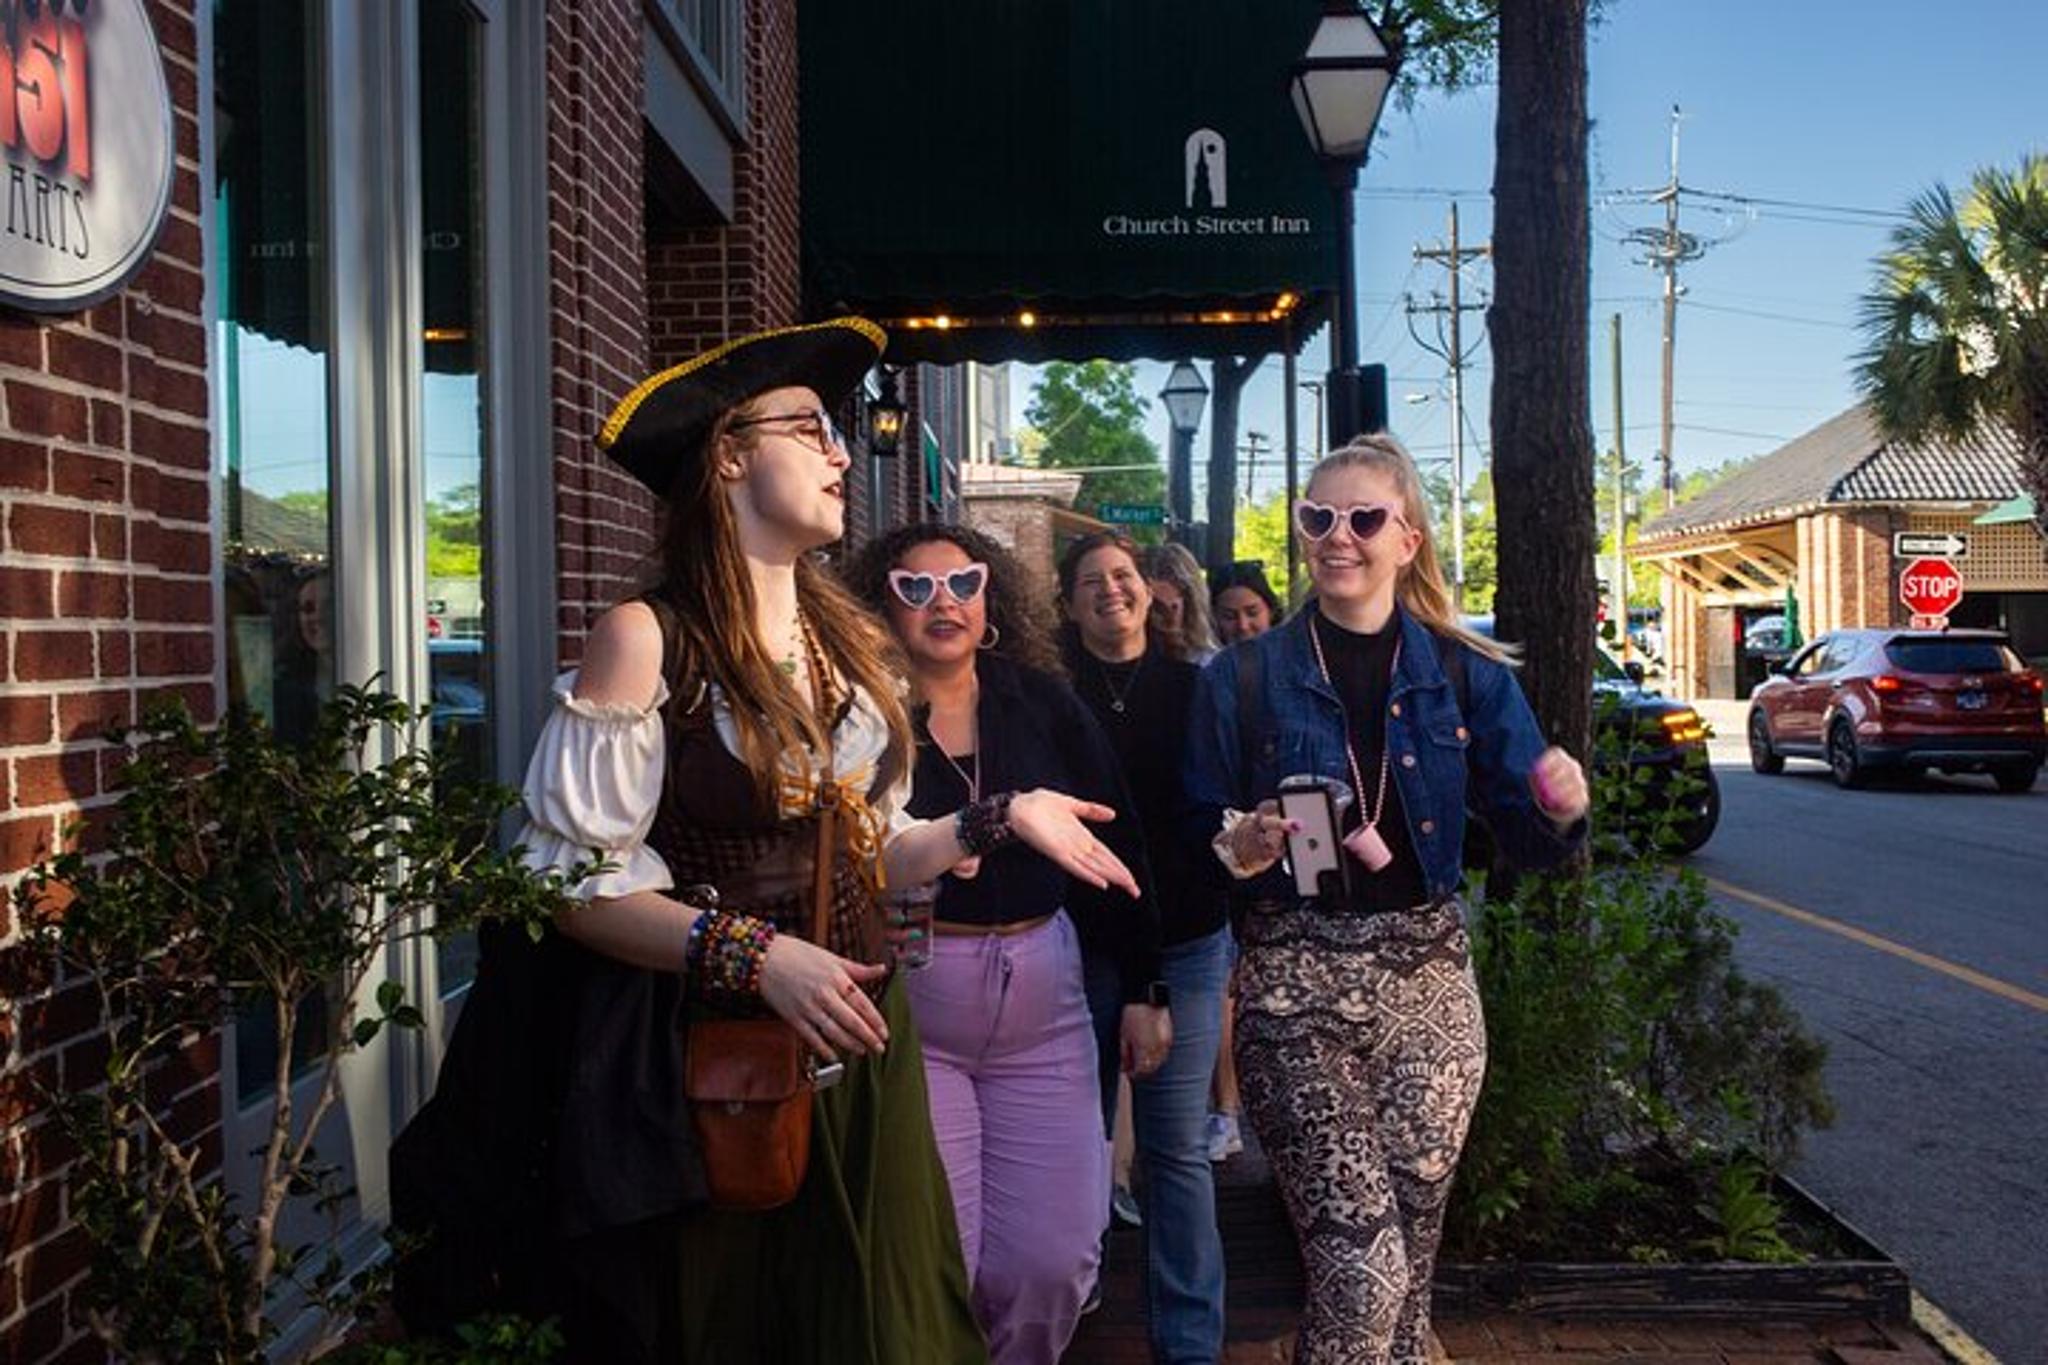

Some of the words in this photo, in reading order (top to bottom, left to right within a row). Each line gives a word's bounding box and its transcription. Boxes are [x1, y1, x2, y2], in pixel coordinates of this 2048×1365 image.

[7, 163, 90, 260] ARTS
[1102, 215, 1190, 234] Church
[1196, 215, 1265, 234] Street
[1271, 215, 1310, 234] Inn
[1905, 576, 1958, 599] STOP
